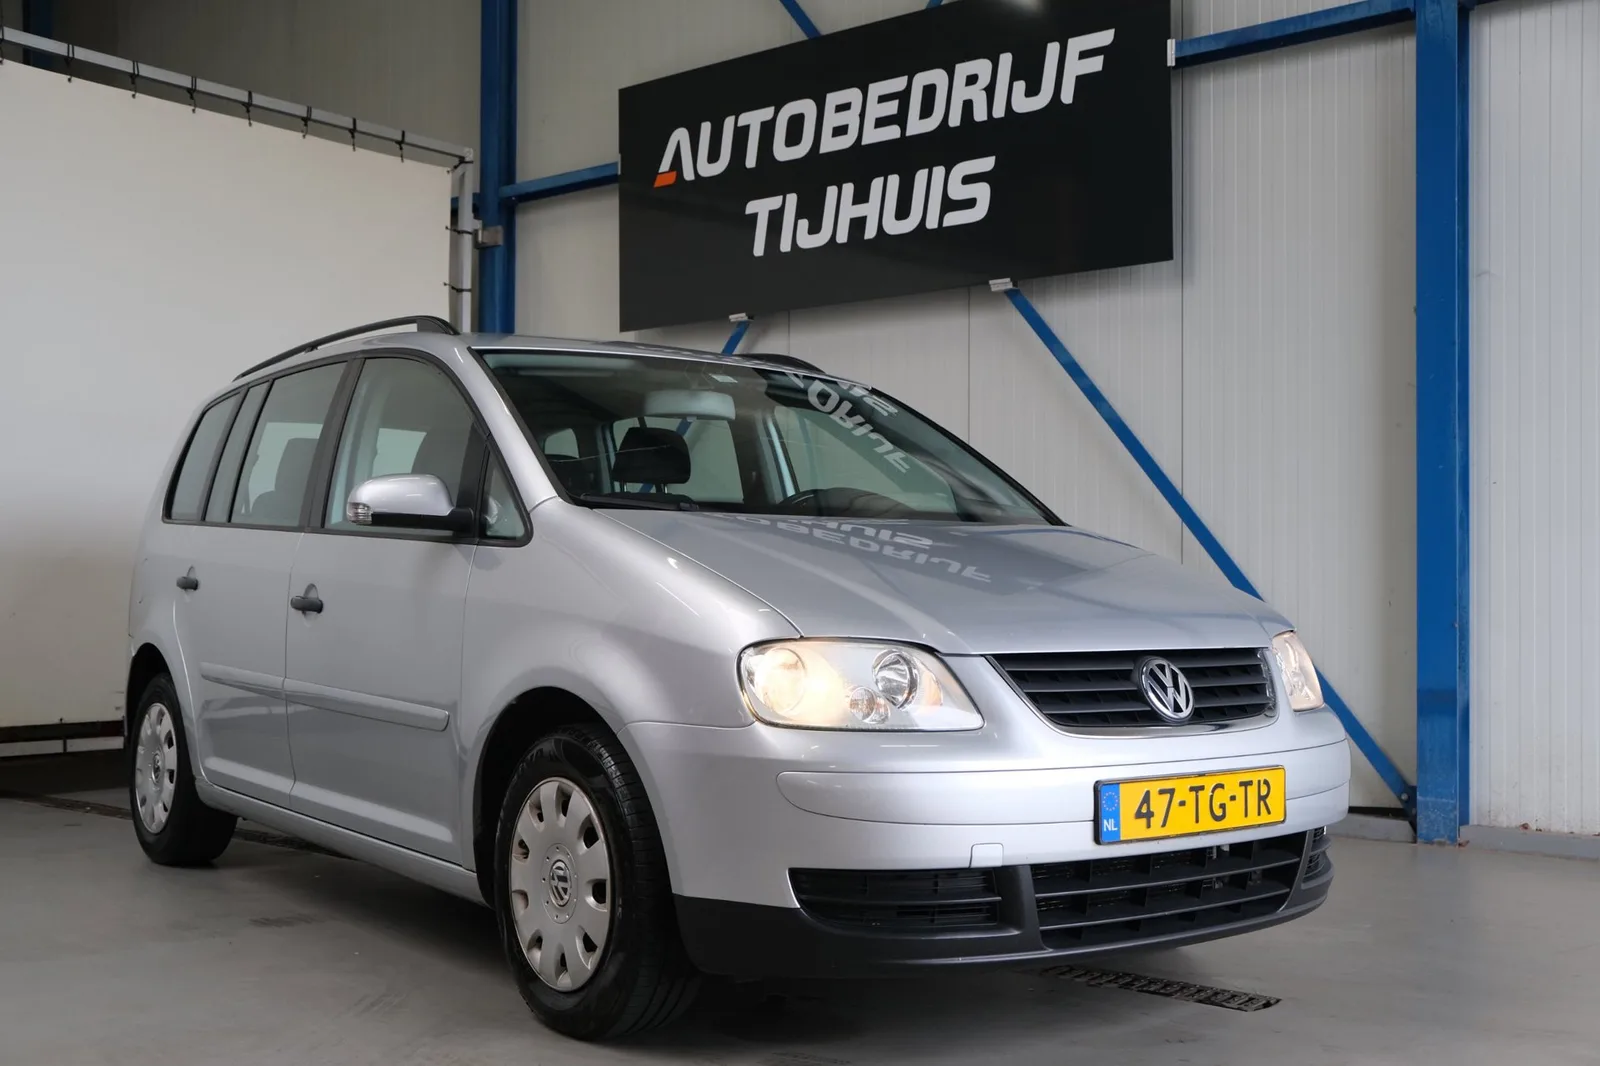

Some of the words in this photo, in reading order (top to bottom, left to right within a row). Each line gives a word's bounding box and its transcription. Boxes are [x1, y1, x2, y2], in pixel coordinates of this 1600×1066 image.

[654, 29, 1115, 188] AUTOBEDRIJF
[745, 156, 996, 257] TIJHUIS
[1103, 818, 1118, 832] NL
[1135, 778, 1272, 829] 47-TG-TR
